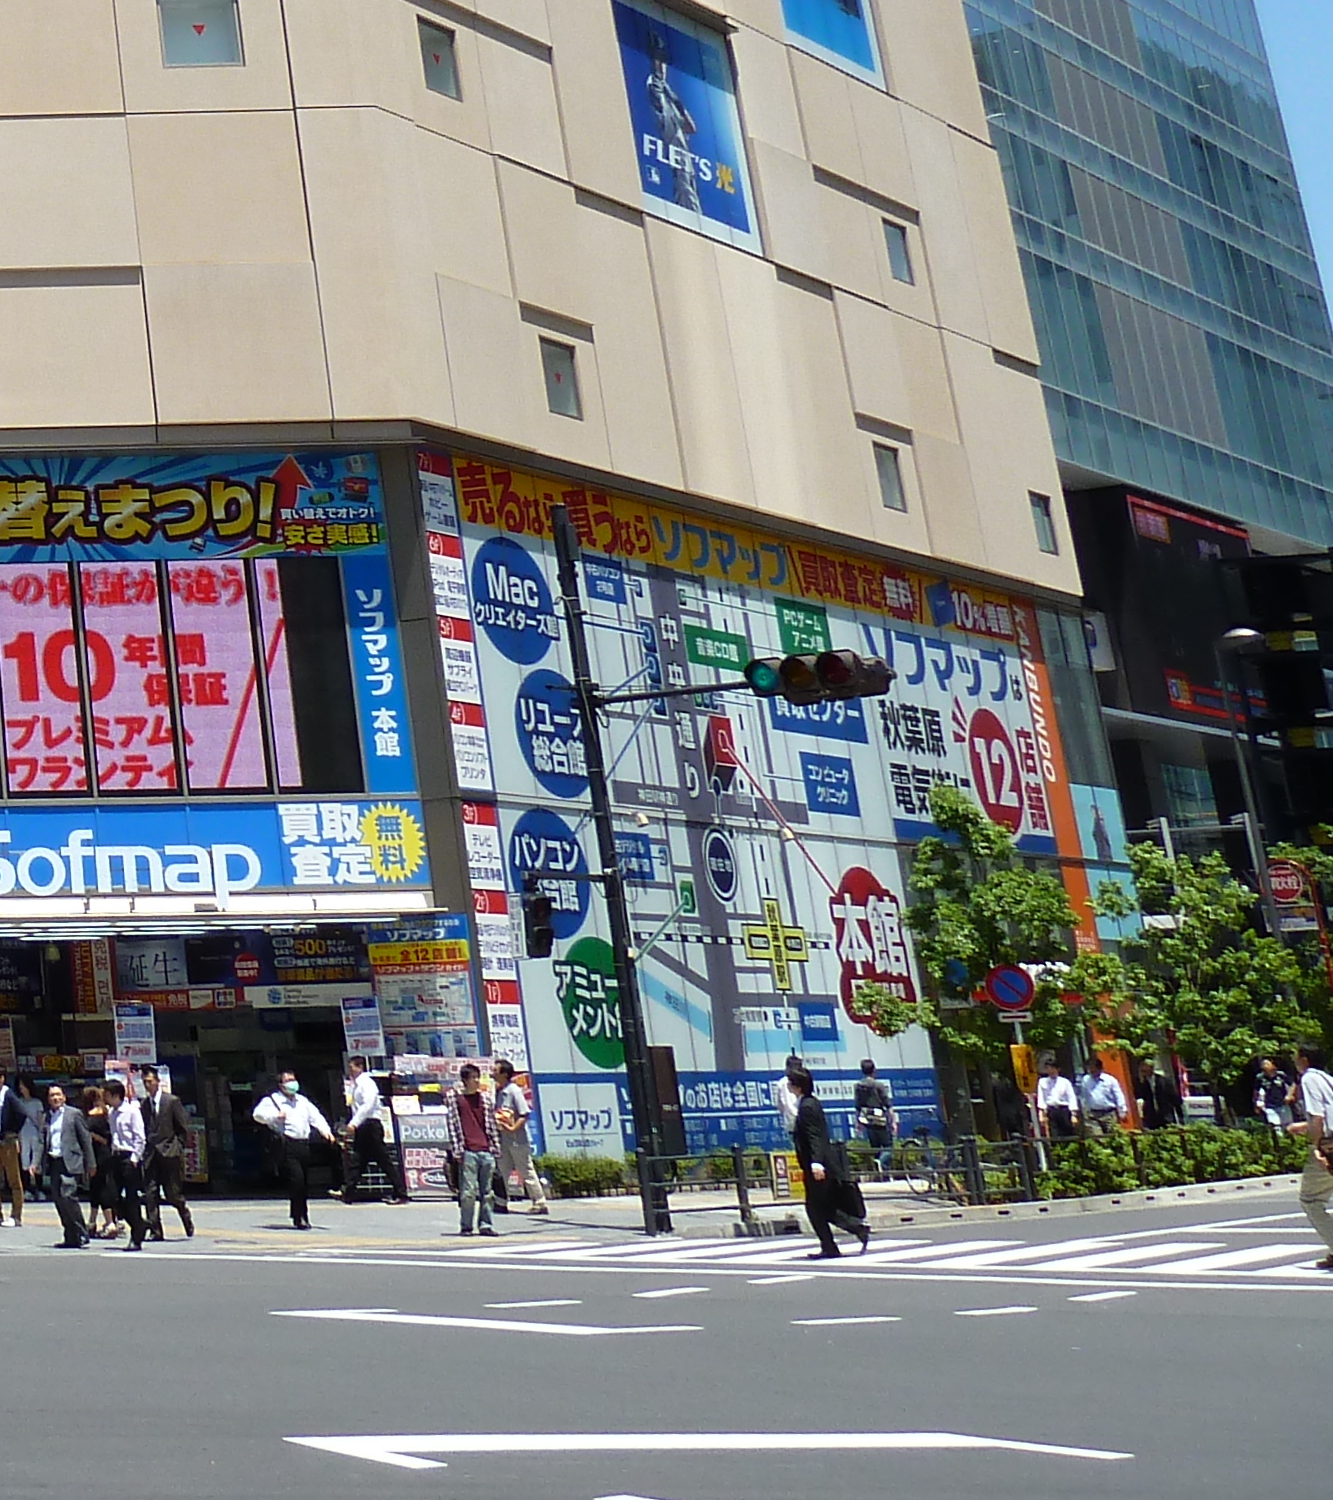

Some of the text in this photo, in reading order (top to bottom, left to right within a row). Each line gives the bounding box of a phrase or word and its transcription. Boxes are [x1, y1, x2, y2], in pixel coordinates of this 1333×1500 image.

[642, 132, 713, 184] FLET'S
[279, 506, 376, 521] 買い替えてオトク!
[283, 523, 380, 546] 安さ実感!
[652, 514, 788, 588] ソフマップ
[484, 561, 540, 608] Mac
[882, 573, 916, 613] 無料
[439, 622, 452, 637] 5F
[473, 604, 560, 642] クリエイターズ館
[782, 605, 823, 631] PCゲーム
[2, 628, 117, 704] 10
[122, 632, 208, 669] 年間
[694, 633, 739, 663] 音楽CD館
[142, 671, 229, 707] 保証
[355, 586, 402, 759] ソフマップ 本館
[450, 705, 463, 721] 4F
[878, 701, 948, 760] 秋葉原
[5, 712, 194, 751] プレミアム
[6, 755, 194, 791] ワランティ
[460, 765, 487, 781] プリンタ
[808, 762, 849, 786] コンピュータ
[974, 736, 1020, 812] 12
[462, 803, 475, 822] 3F
[816, 784, 849, 805] クリニック
[278, 802, 364, 844] 買取
[471, 833, 493, 848] テレビ
[374, 814, 406, 872] 無料
[514, 833, 580, 872] パソコン
[289, 843, 377, 886] 査定
[473, 893, 487, 911] 2F
[533, 877, 580, 912] 合館
[294, 938, 326, 957] 500
[386, 927, 446, 941] ソフマップ
[832, 893, 909, 977] 本館
[486, 982, 500, 1001] 1F
[552, 961, 620, 1001] アミュー
[401, 1124, 446, 1141] Pocke
[549, 1106, 614, 1133] ソフマップ
